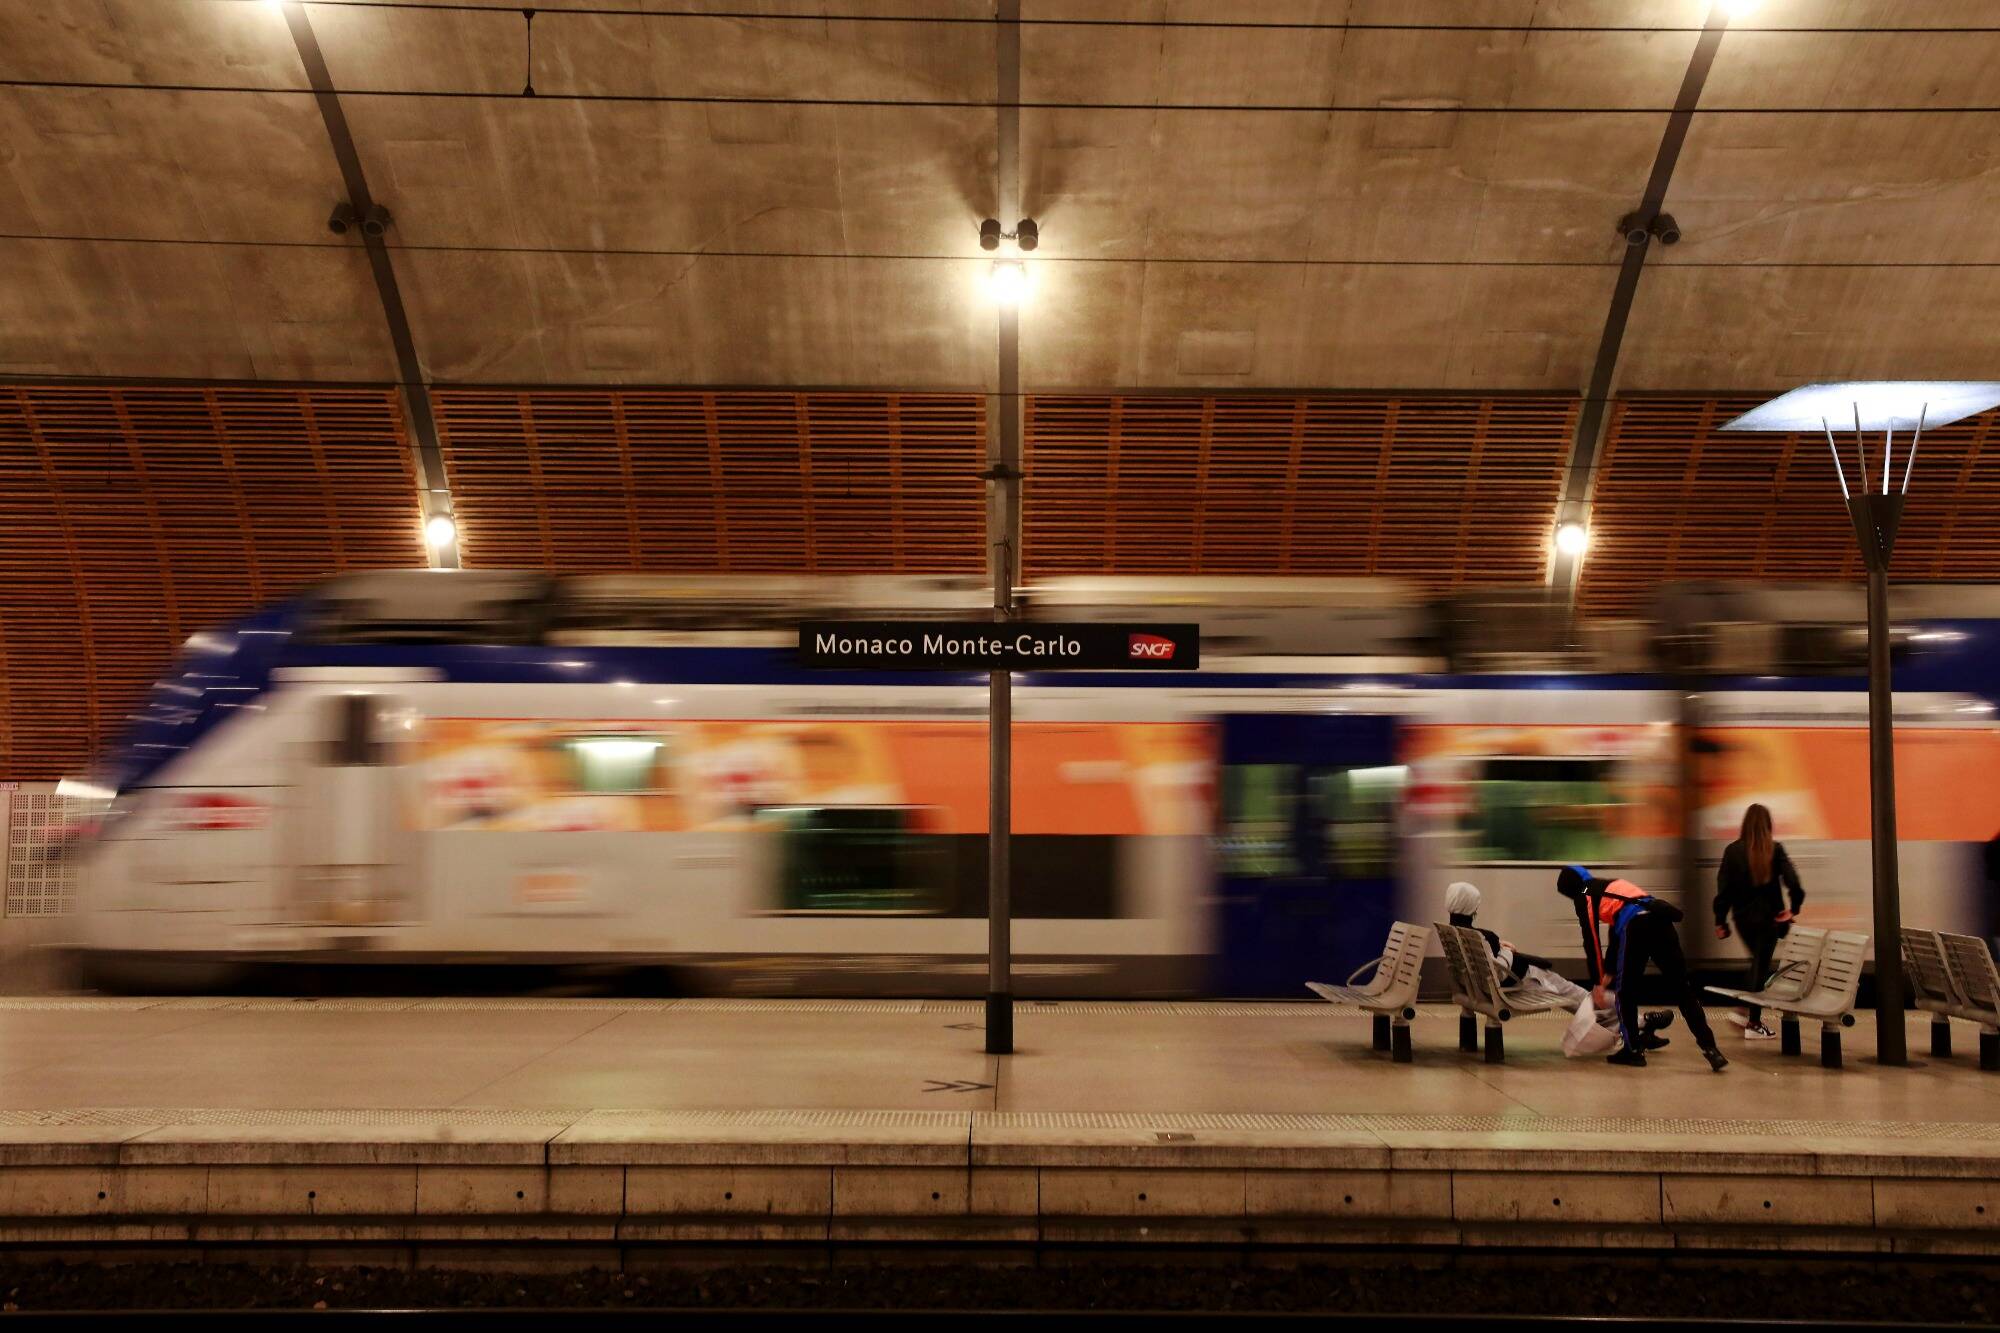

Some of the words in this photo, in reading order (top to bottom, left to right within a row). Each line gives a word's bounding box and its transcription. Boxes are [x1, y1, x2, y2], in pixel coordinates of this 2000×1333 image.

[815, 633, 913, 655] Monaco
[923, 633, 1081, 656] Monte-Carlo
[1130, 642, 1173, 656] SNCF
